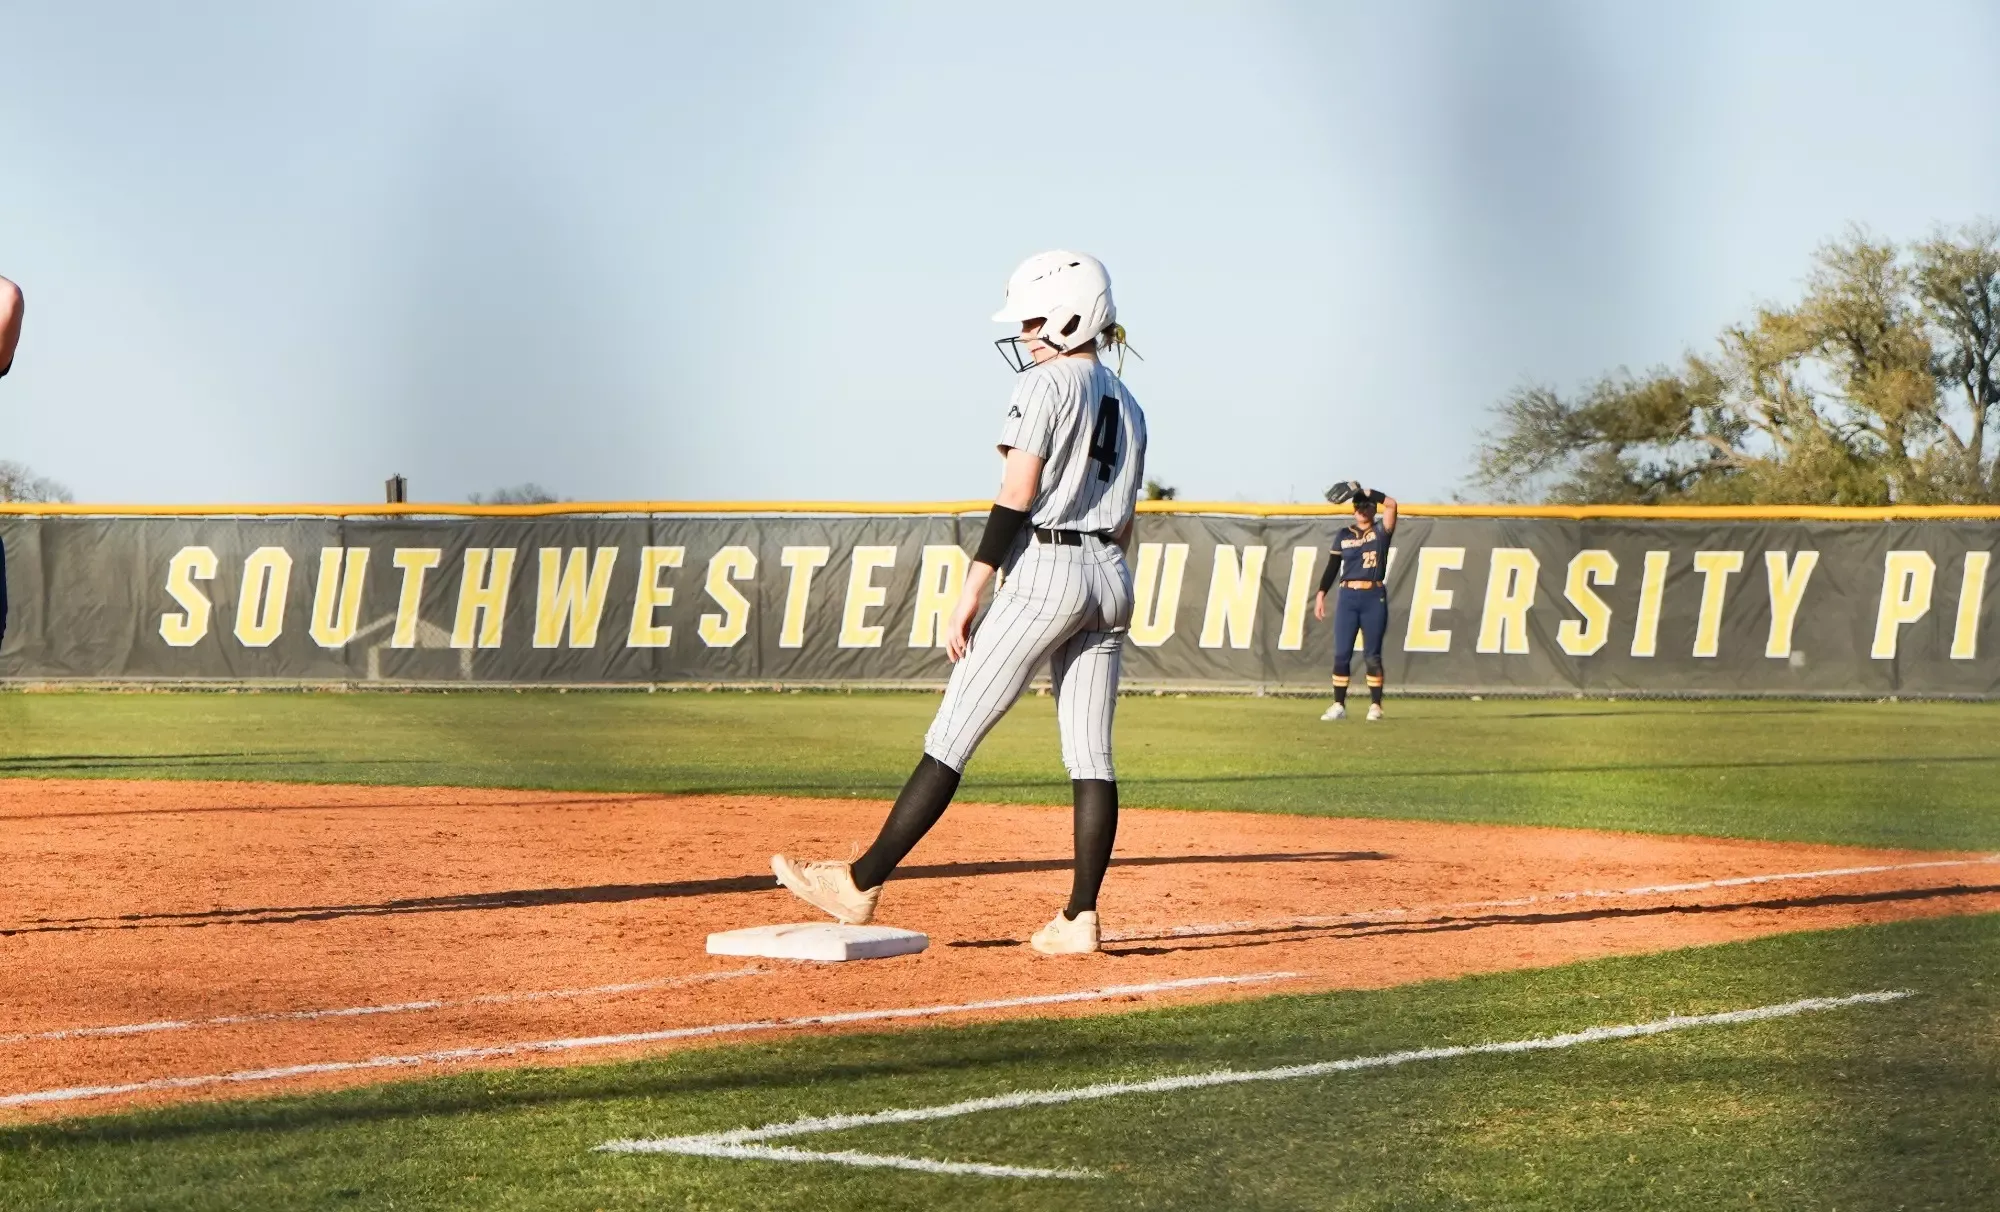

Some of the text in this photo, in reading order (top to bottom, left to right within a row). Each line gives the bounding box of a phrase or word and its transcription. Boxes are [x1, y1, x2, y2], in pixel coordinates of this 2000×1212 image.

[1088, 394, 1120, 483] 4
[158, 545, 1003, 649] SOUTHWESTER
[1128, 542, 1820, 659] UNIERSITY
[1362, 551, 1377, 569] 25
